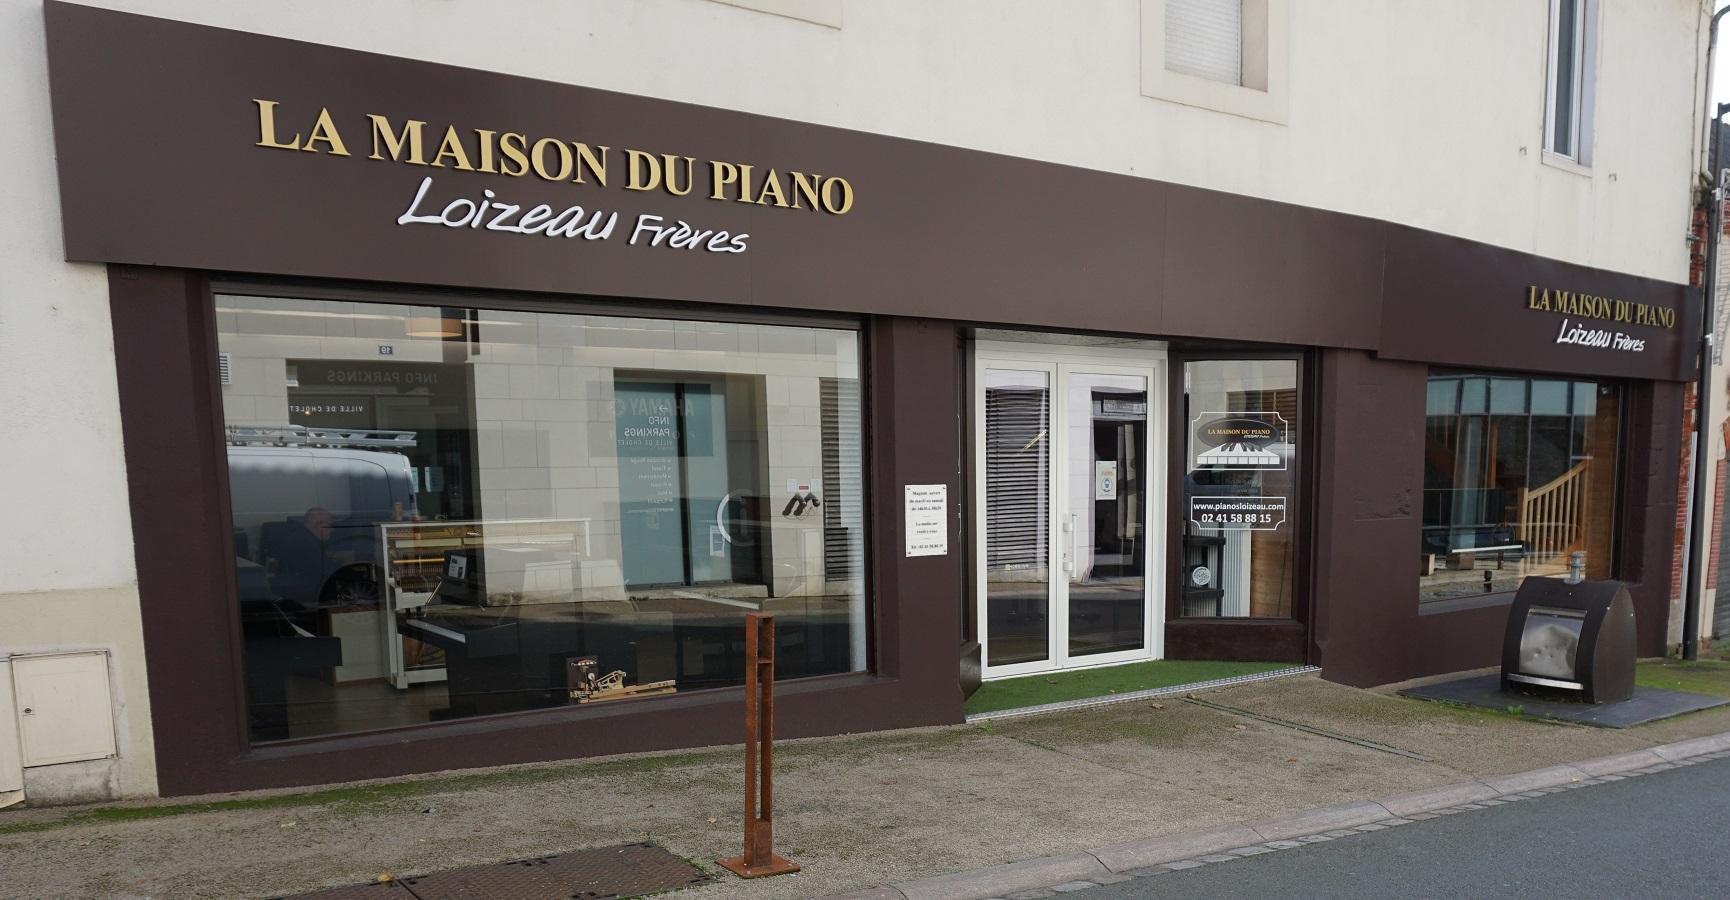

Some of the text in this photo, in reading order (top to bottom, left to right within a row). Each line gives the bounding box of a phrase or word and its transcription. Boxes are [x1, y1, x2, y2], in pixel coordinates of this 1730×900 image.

[253, 98, 854, 215] LA MAISON DU PIANO
[397, 176, 751, 253] Loizeau Frères
[1529, 285, 1676, 329] LA MAISON DU PIANO
[1556, 318, 1646, 352] Loizeau Frères
[1193, 502, 1284, 511] www.pianosloizeau.com
[1201, 513, 1271, 523] 02 41 58 88 15
